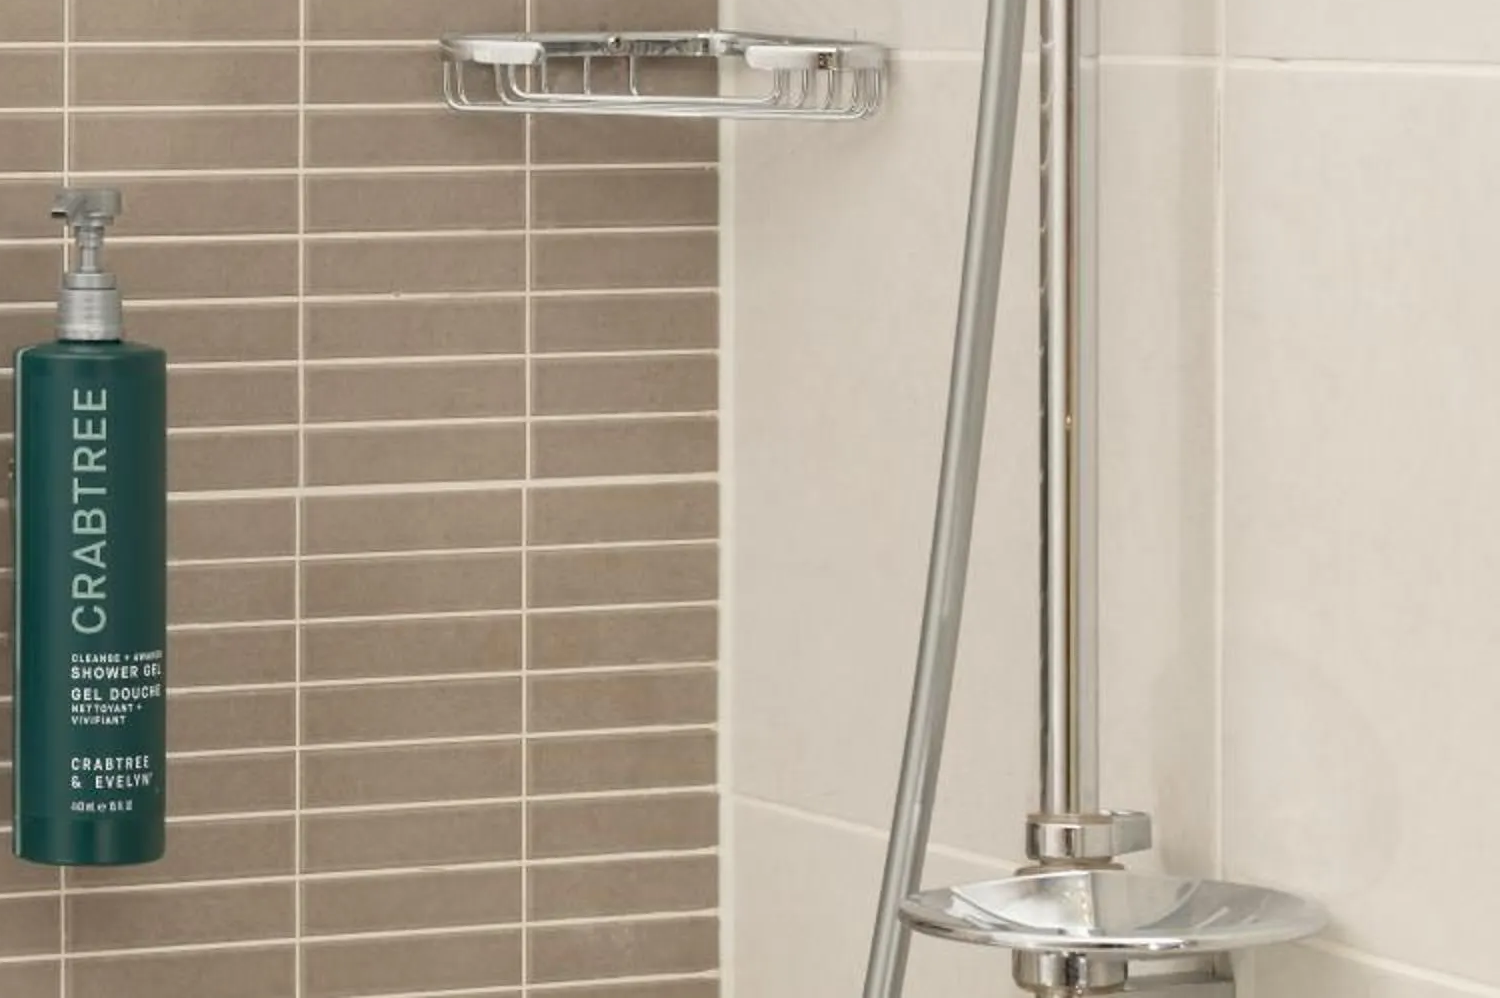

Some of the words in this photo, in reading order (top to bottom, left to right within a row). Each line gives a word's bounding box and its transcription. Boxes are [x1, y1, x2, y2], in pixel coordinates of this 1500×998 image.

[71, 388, 107, 634] CRABTREE
[71, 665, 139, 679] SHOWER
[143, 662, 161, 677] GEL
[71, 687, 102, 701] GEL
[109, 684, 161, 701] DOUCHE
[71, 703, 133, 713] NETTOYANT
[71, 755, 149, 771] CRABTREE
[71, 775, 82, 789] &
